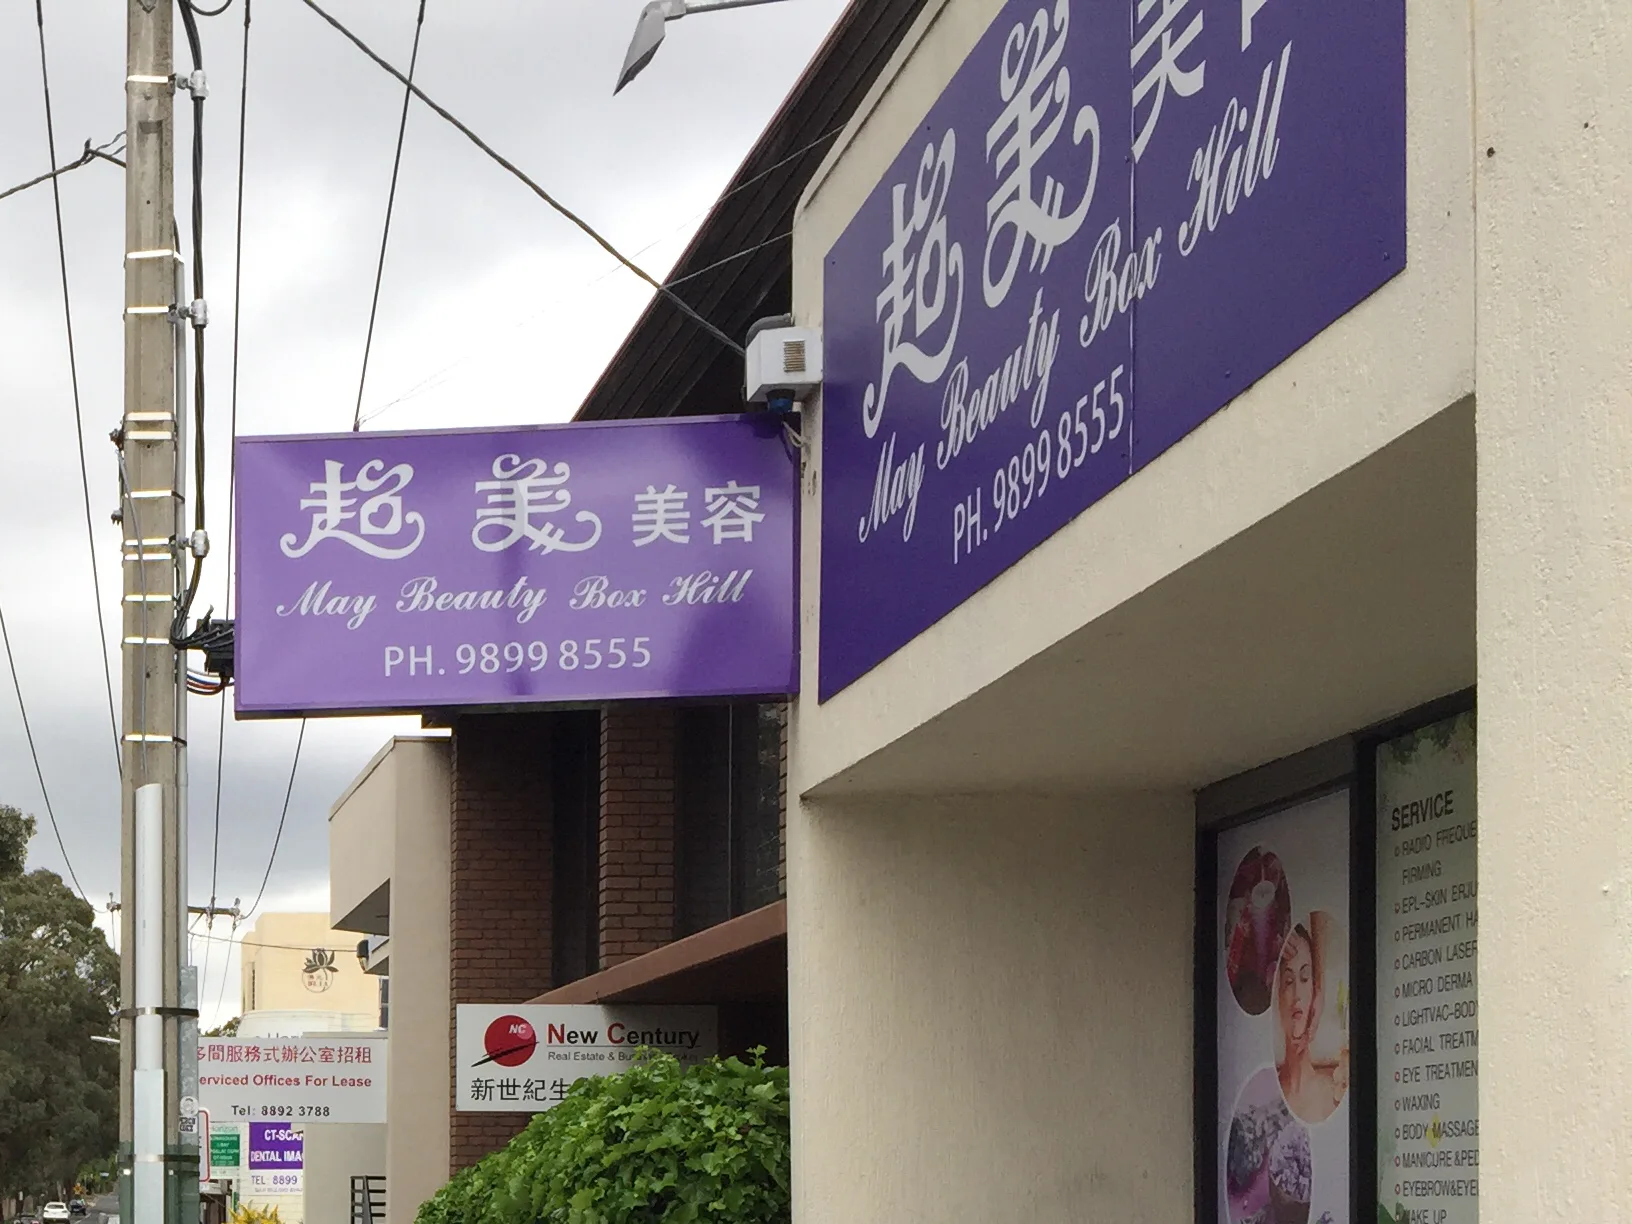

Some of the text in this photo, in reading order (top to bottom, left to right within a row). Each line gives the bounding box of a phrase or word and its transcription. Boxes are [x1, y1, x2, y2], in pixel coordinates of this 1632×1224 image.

[859, 40, 1293, 544] May Beauty Box Hill
[954, 364, 1125, 565] PH. 9899 8555
[276, 568, 754, 630] May Beauty Box Hill
[384, 636, 651, 678] PH. 9899 8555
[1391, 790, 1454, 832] SERVICE
[1402, 833, 1432, 856] RADIO
[1402, 860, 1442, 886] FIRMING
[1402, 888, 1448, 914] EPL-SKIN
[1402, 913, 1461, 942] PERMANENT
[1402, 948, 1442, 970] CARBON
[1402, 971, 1473, 998] MICRO DERMA
[508, 1023, 526, 1035] NC
[547, 1022, 700, 1049] New Century
[548, 1051, 570, 1061] Real
[573, 1051, 605, 1062] Estate
[607, 1051, 615, 1062] &
[1402, 1036, 1435, 1056] FACIAL
[199, 1074, 372, 1087] erviced Offices For Lease
[1402, 1066, 1421, 1084] EYE
[231, 1105, 330, 1117] Tel: 8892 3788
[1402, 1093, 1441, 1111] WAXING
[1402, 1119, 1479, 1140] BODY MASSAGE
[250, 1150, 282, 1162] DENTAL
[283, 1150, 303, 1162] IMA
[1402, 1150, 1452, 1168] MANICURE
[272, 1175, 298, 1185] 8899
